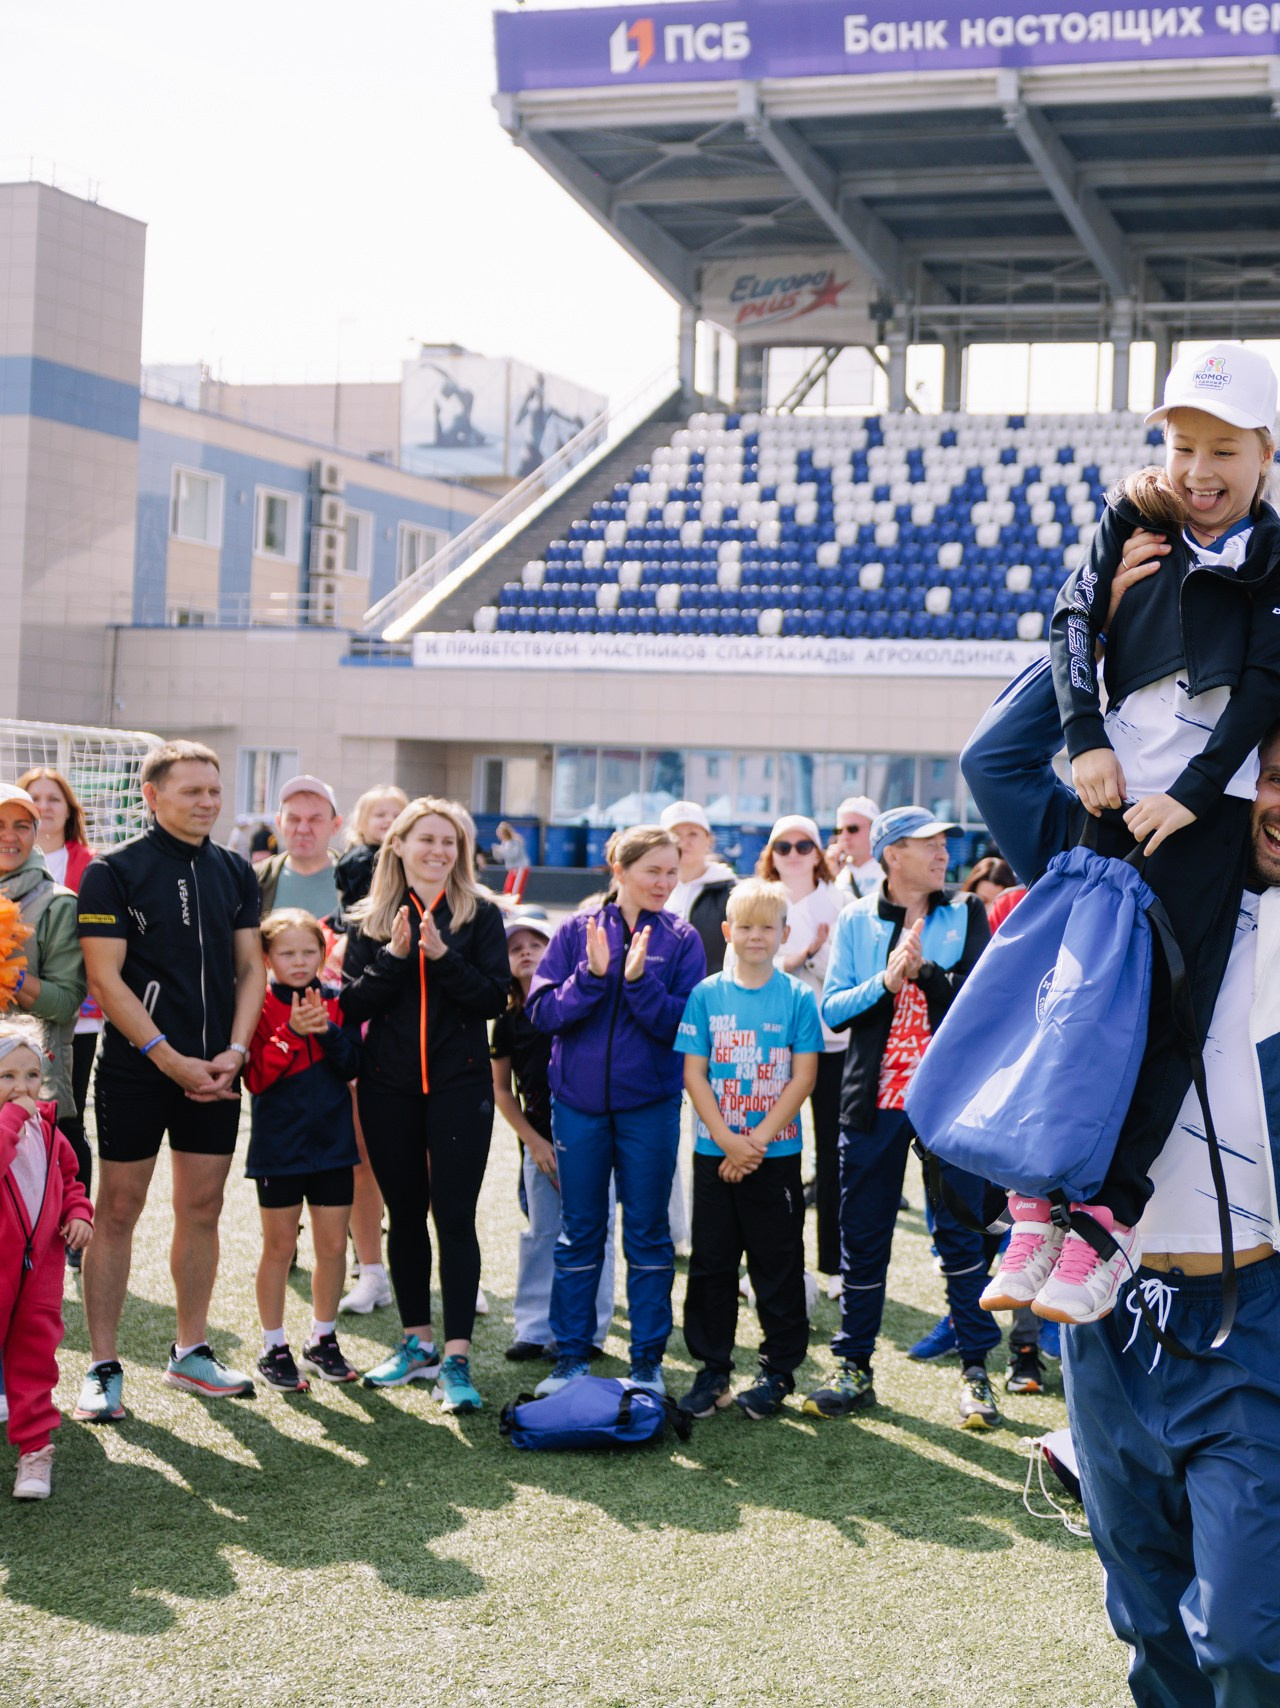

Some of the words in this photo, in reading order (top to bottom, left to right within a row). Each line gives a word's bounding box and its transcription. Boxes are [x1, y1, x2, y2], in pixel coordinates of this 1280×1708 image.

[843, 15, 950, 54] Банк
[960, 6, 1204, 48] настоящих
[664, 21, 751, 63] ПСБ
[1195, 373, 1229, 382] КОМОС
[445, 641, 578, 657] ПРИВЕТСТВУЕМ
[590, 641, 707, 659] УЧАСТНИКОВ
[716, 643, 853, 664] СПАРТАКИАДЫ
[866, 646, 1016, 666] АГРОХОЛДИНГА
[709, 1014, 737, 1032] 2024
[713, 1029, 757, 1047] #МЕЧТА
